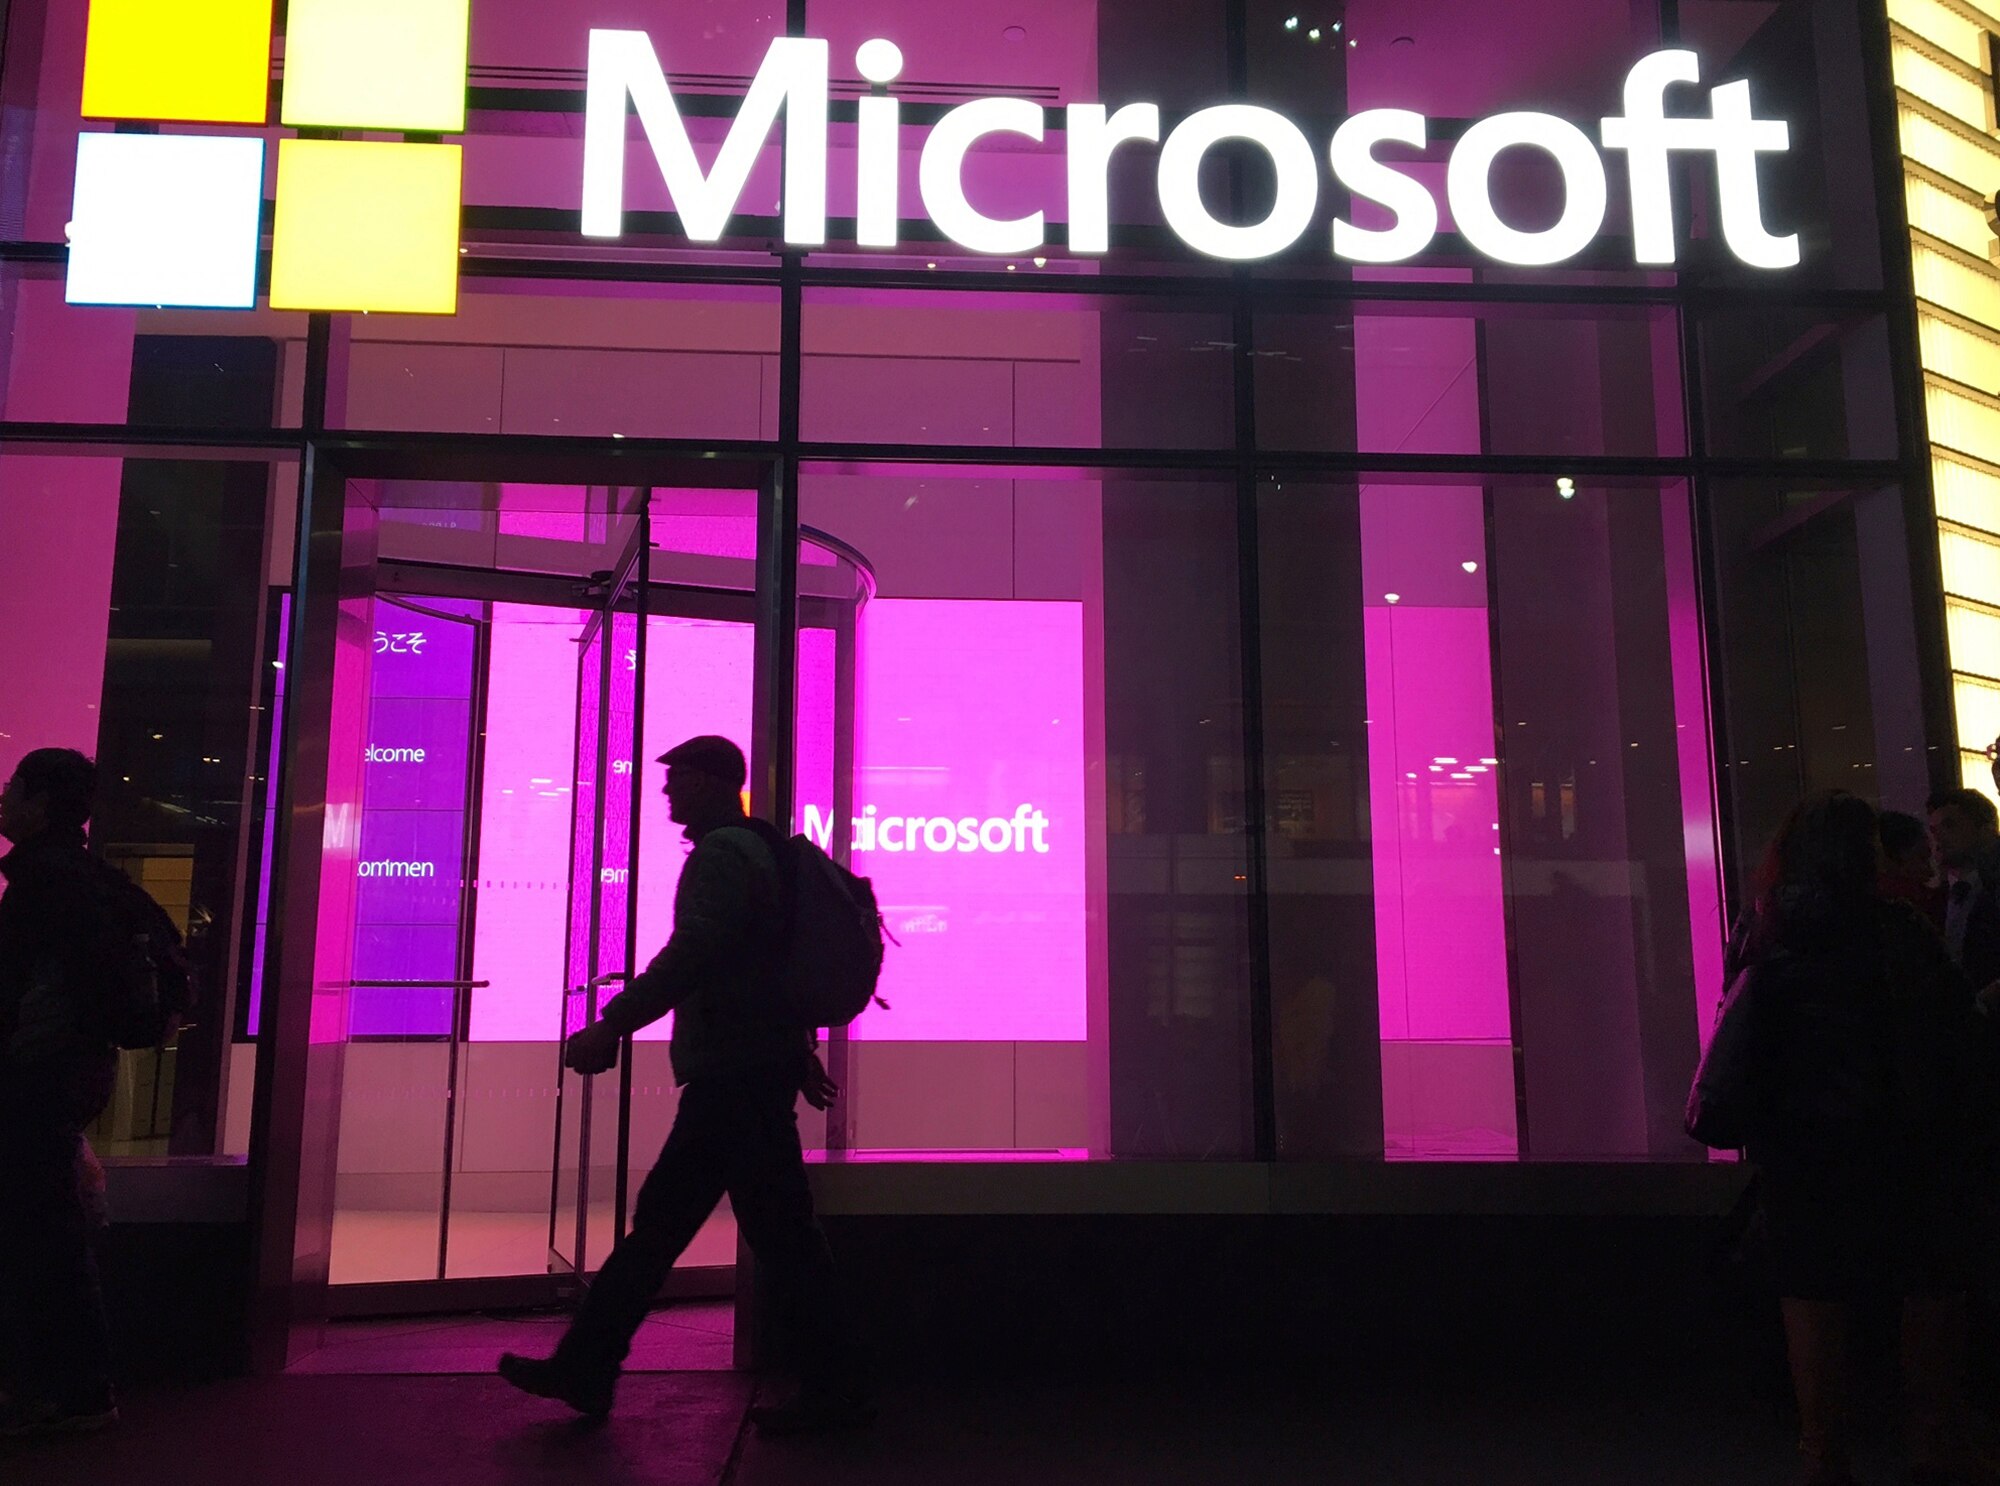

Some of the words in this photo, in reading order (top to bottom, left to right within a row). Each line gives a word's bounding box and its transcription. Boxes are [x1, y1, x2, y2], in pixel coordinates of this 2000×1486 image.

[580, 28, 1801, 270] Microsoft
[373, 631, 428, 655] うこそ
[357, 859, 435, 879] ommen
